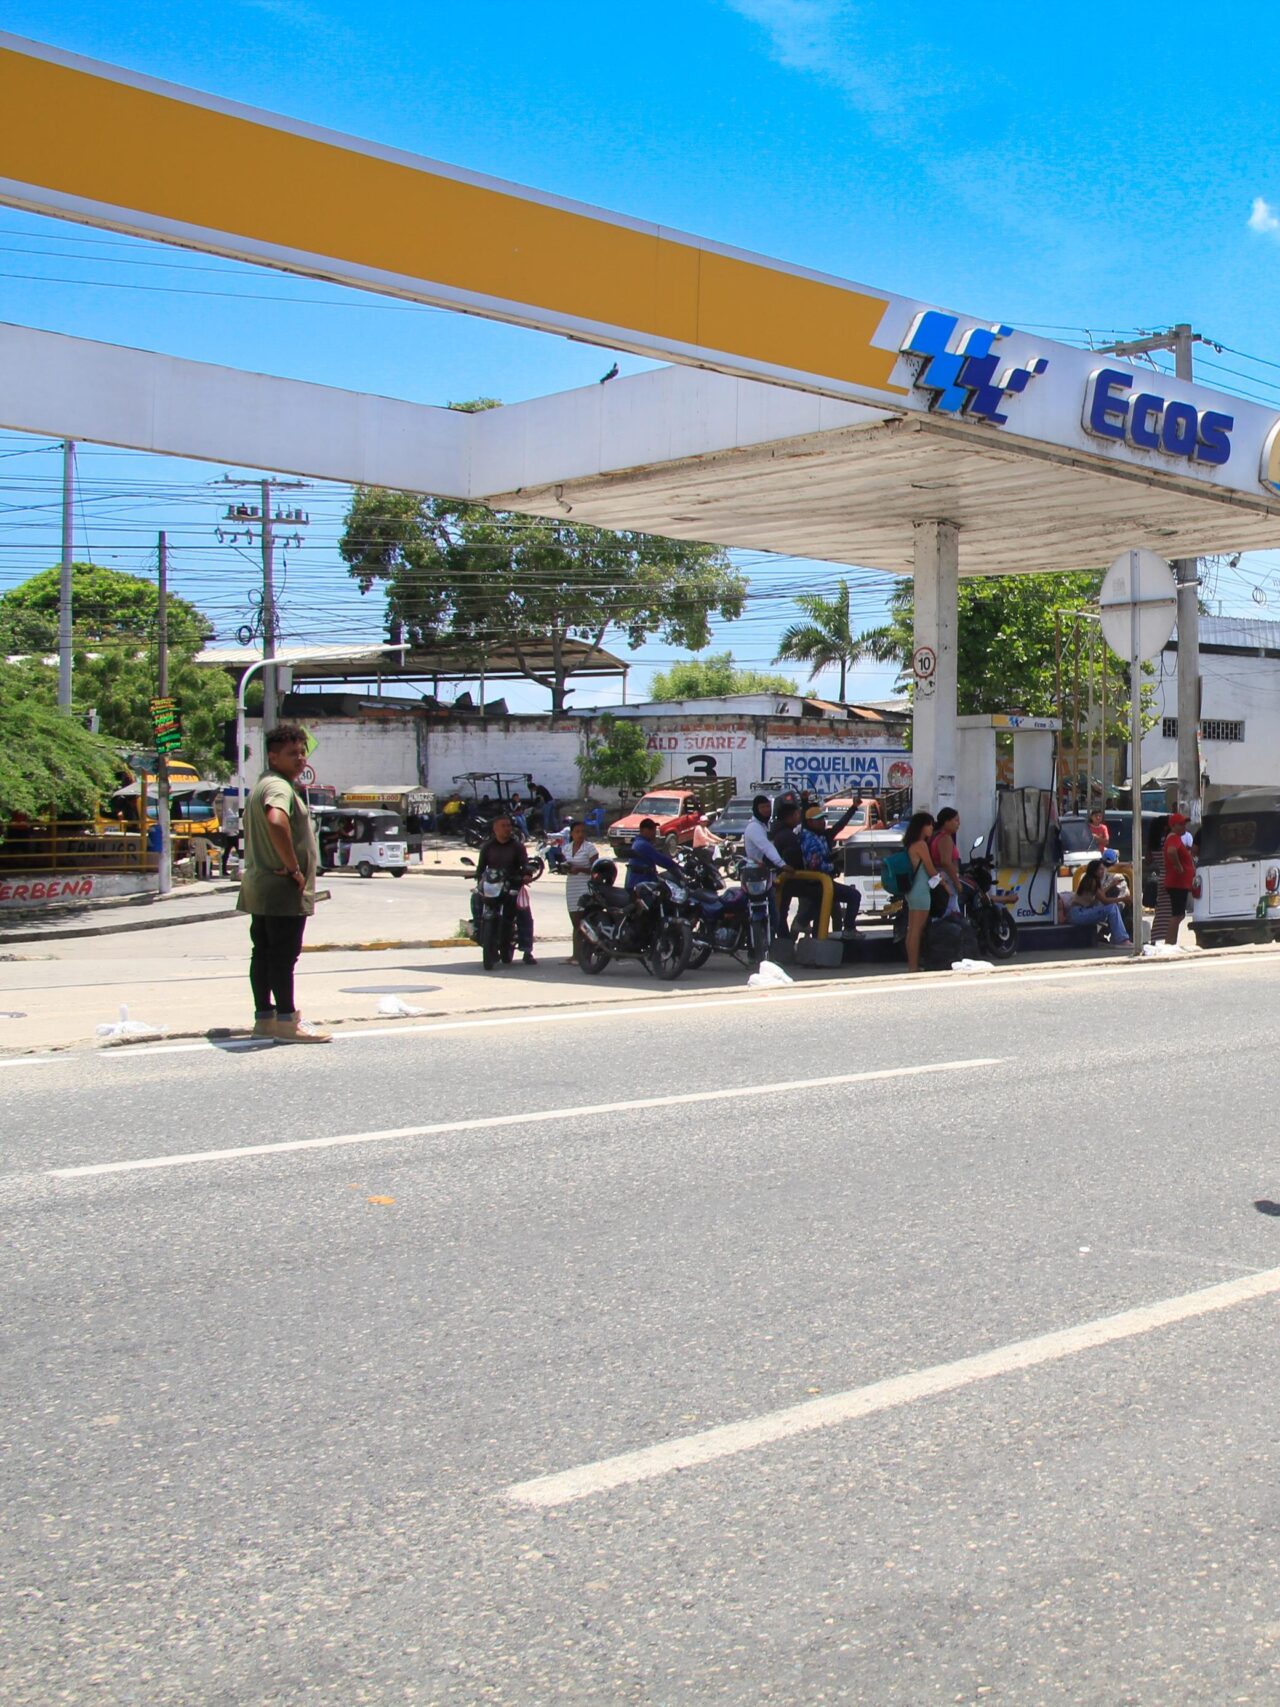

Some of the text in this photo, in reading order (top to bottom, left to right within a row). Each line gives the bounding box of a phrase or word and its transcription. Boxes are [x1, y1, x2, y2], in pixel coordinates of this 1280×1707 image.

[918, 656, 931, 671] 10
[646, 735, 748, 750] ALD SUAREZ
[686, 754, 718, 778] 3
[784, 756, 880, 773] ROQUELINA
[301, 770, 313, 781] 30
[785, 774, 880, 794] BLANCO
